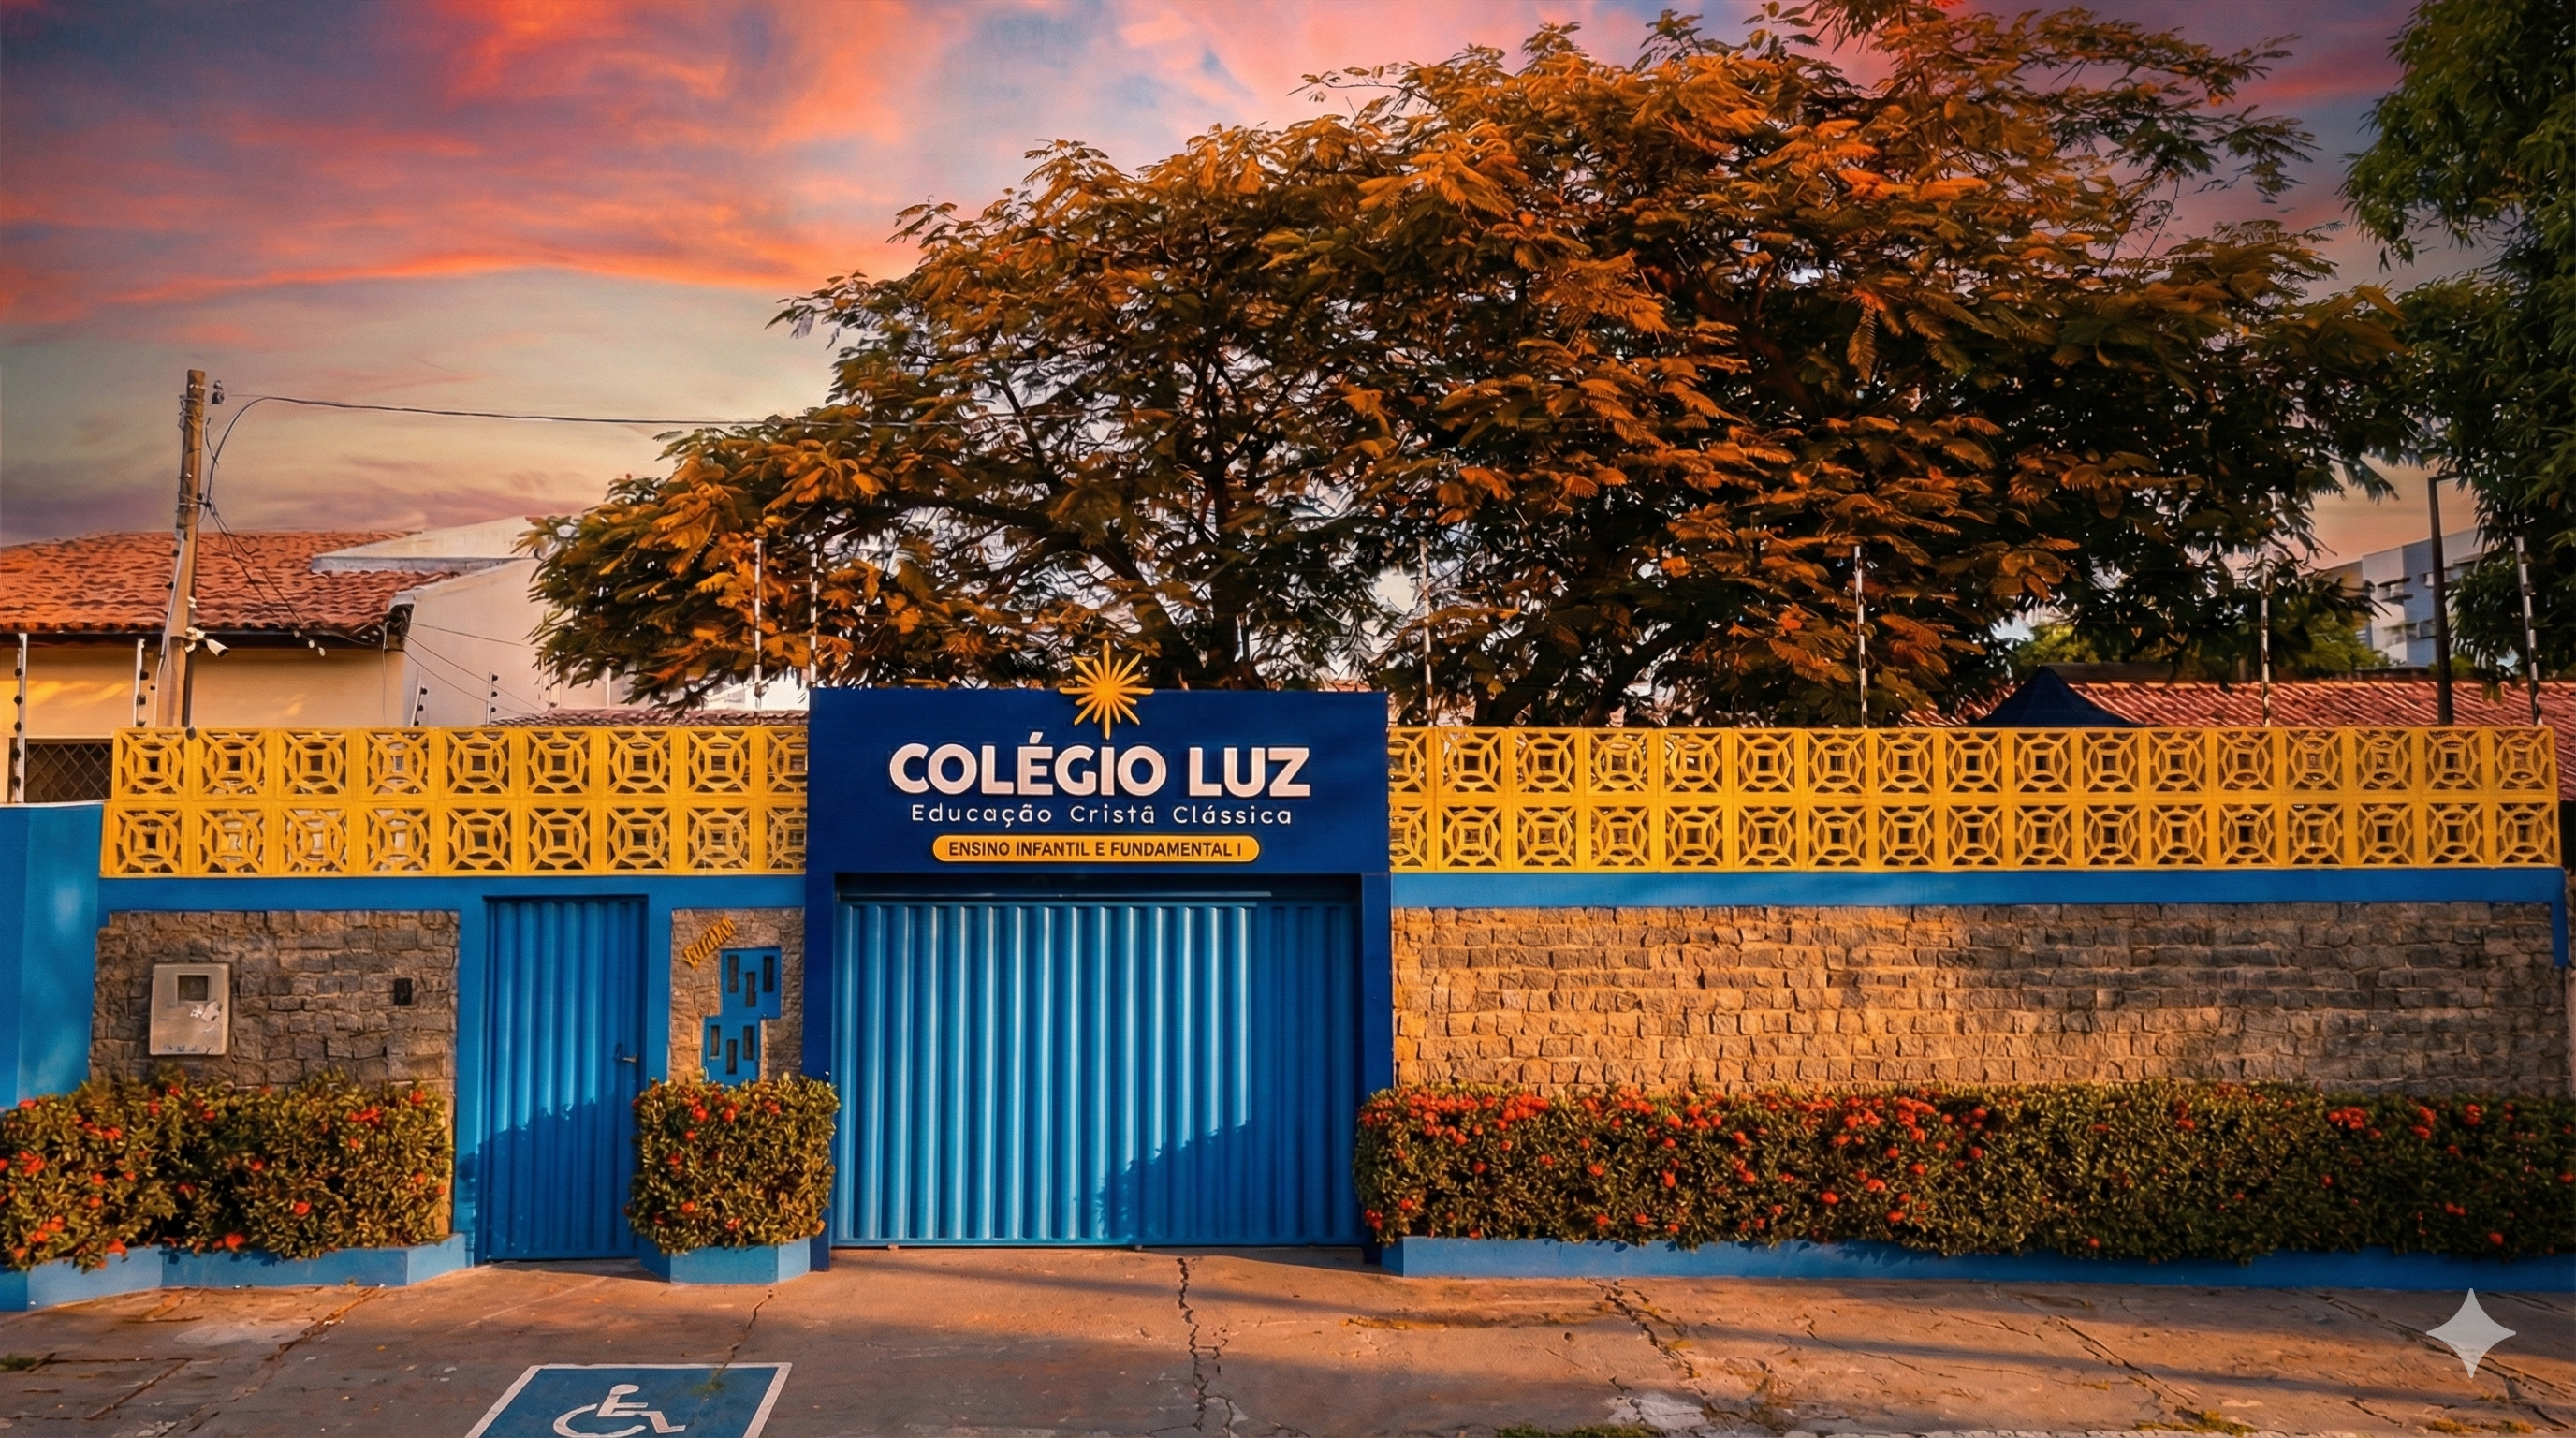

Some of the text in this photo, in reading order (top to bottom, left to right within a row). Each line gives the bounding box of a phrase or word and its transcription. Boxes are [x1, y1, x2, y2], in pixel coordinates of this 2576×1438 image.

[888, 731, 1310, 798] COLÉGIO LUZ
[911, 803, 1292, 828] Educação Cristã Clássica
[948, 841, 1010, 857] ENSINO
[1016, 841, 1090, 857] INFANTIL
[1095, 842, 1105, 857] E
[1110, 841, 1233, 857] FUNDAMENTAL
